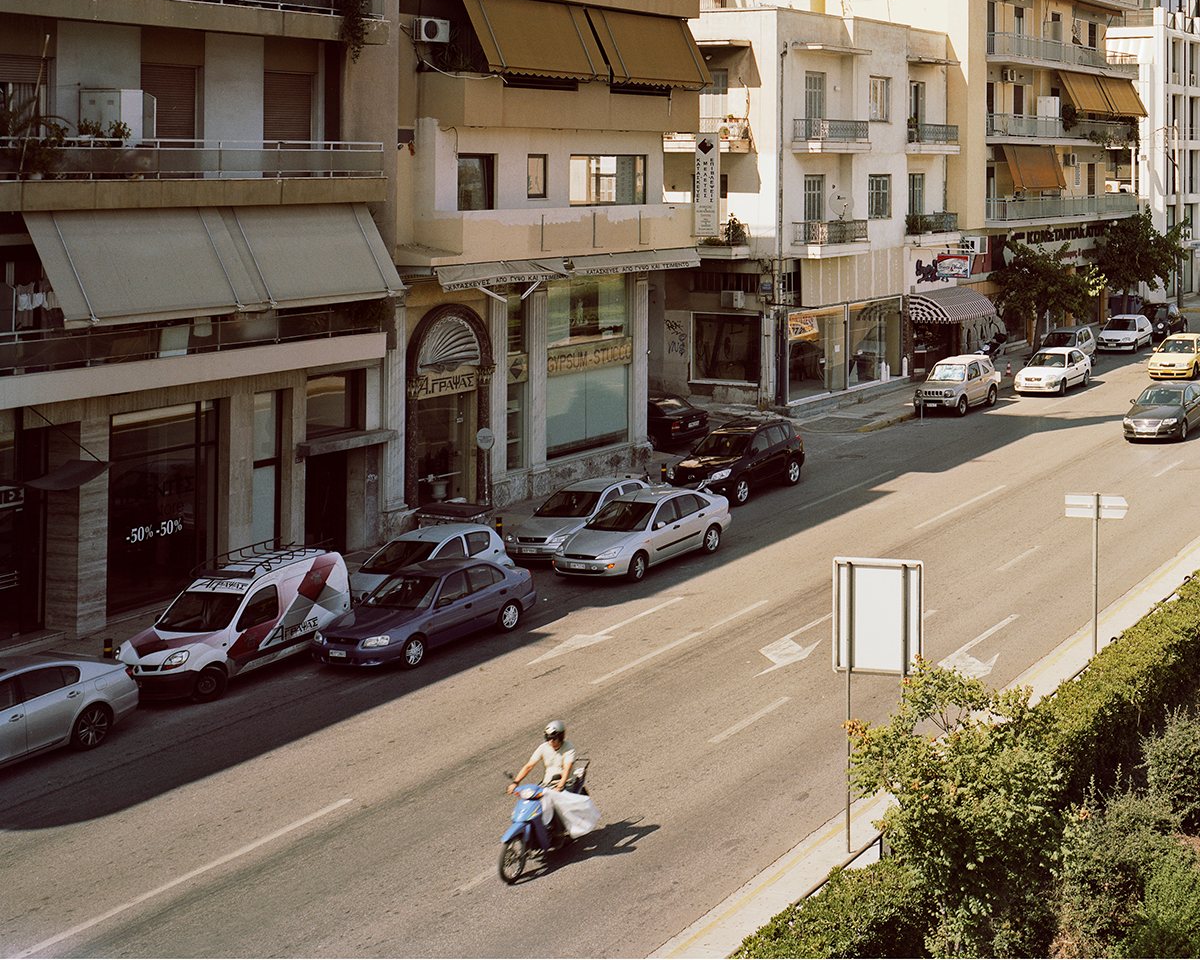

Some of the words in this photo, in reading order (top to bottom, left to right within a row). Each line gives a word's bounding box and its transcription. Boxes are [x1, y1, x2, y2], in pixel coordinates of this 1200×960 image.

[447, 278, 491, 291] ΚΑΤΑΣΚΕΥΕΣ
[125, 524, 154, 544] -50%
[155, 517, 183, 537] -50%
